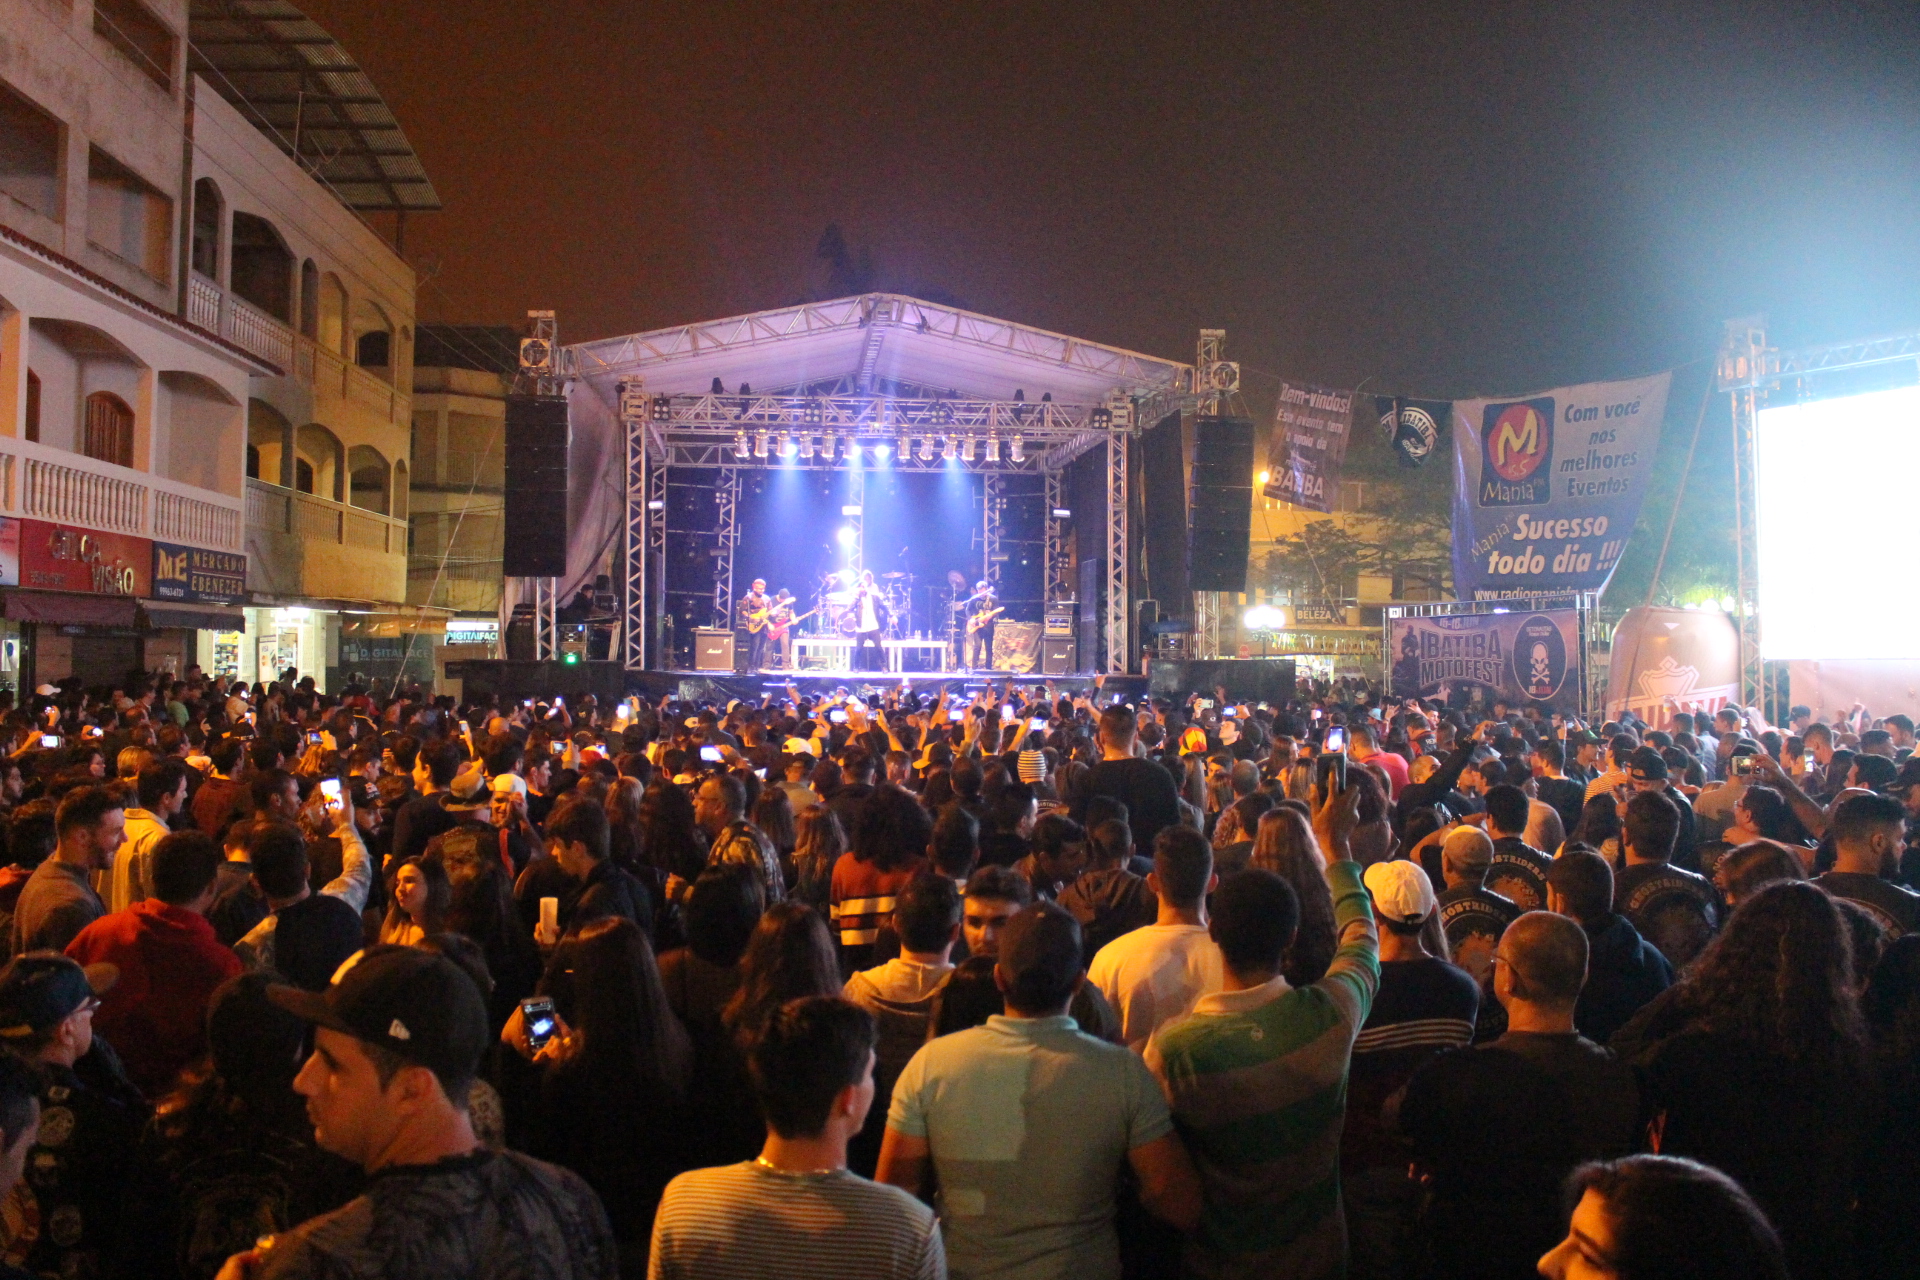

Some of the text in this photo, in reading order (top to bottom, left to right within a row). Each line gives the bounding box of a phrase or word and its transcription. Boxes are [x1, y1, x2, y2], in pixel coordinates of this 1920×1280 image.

[1280, 383, 1352, 413] Bem-vindos!
[1564, 396, 1640, 423] Com você
[1327, 420, 1343, 433] tem
[1589, 428, 1616, 445] nos
[1560, 449, 1637, 472] melhores
[1483, 481, 1534, 502] Mania
[1567, 477, 1629, 498] Eventos
[1513, 513, 1608, 541] Sucesso
[1470, 522, 1511, 563] Mania
[157, 548, 188, 582] ME
[192, 551, 244, 572] MERCADO
[1488, 546, 1545, 574] todo
[1553, 543, 1592, 574] dia
[191, 575, 243, 596] EBENEZER
[1297, 610, 1332, 620] BELEZA
[360, 648, 429, 659] DGITALACE
[1420, 629, 1502, 660] IBATIBA
[1421, 659, 1502, 687] MOTOFEST
[1492, 854, 1546, 881] STRIDERS
